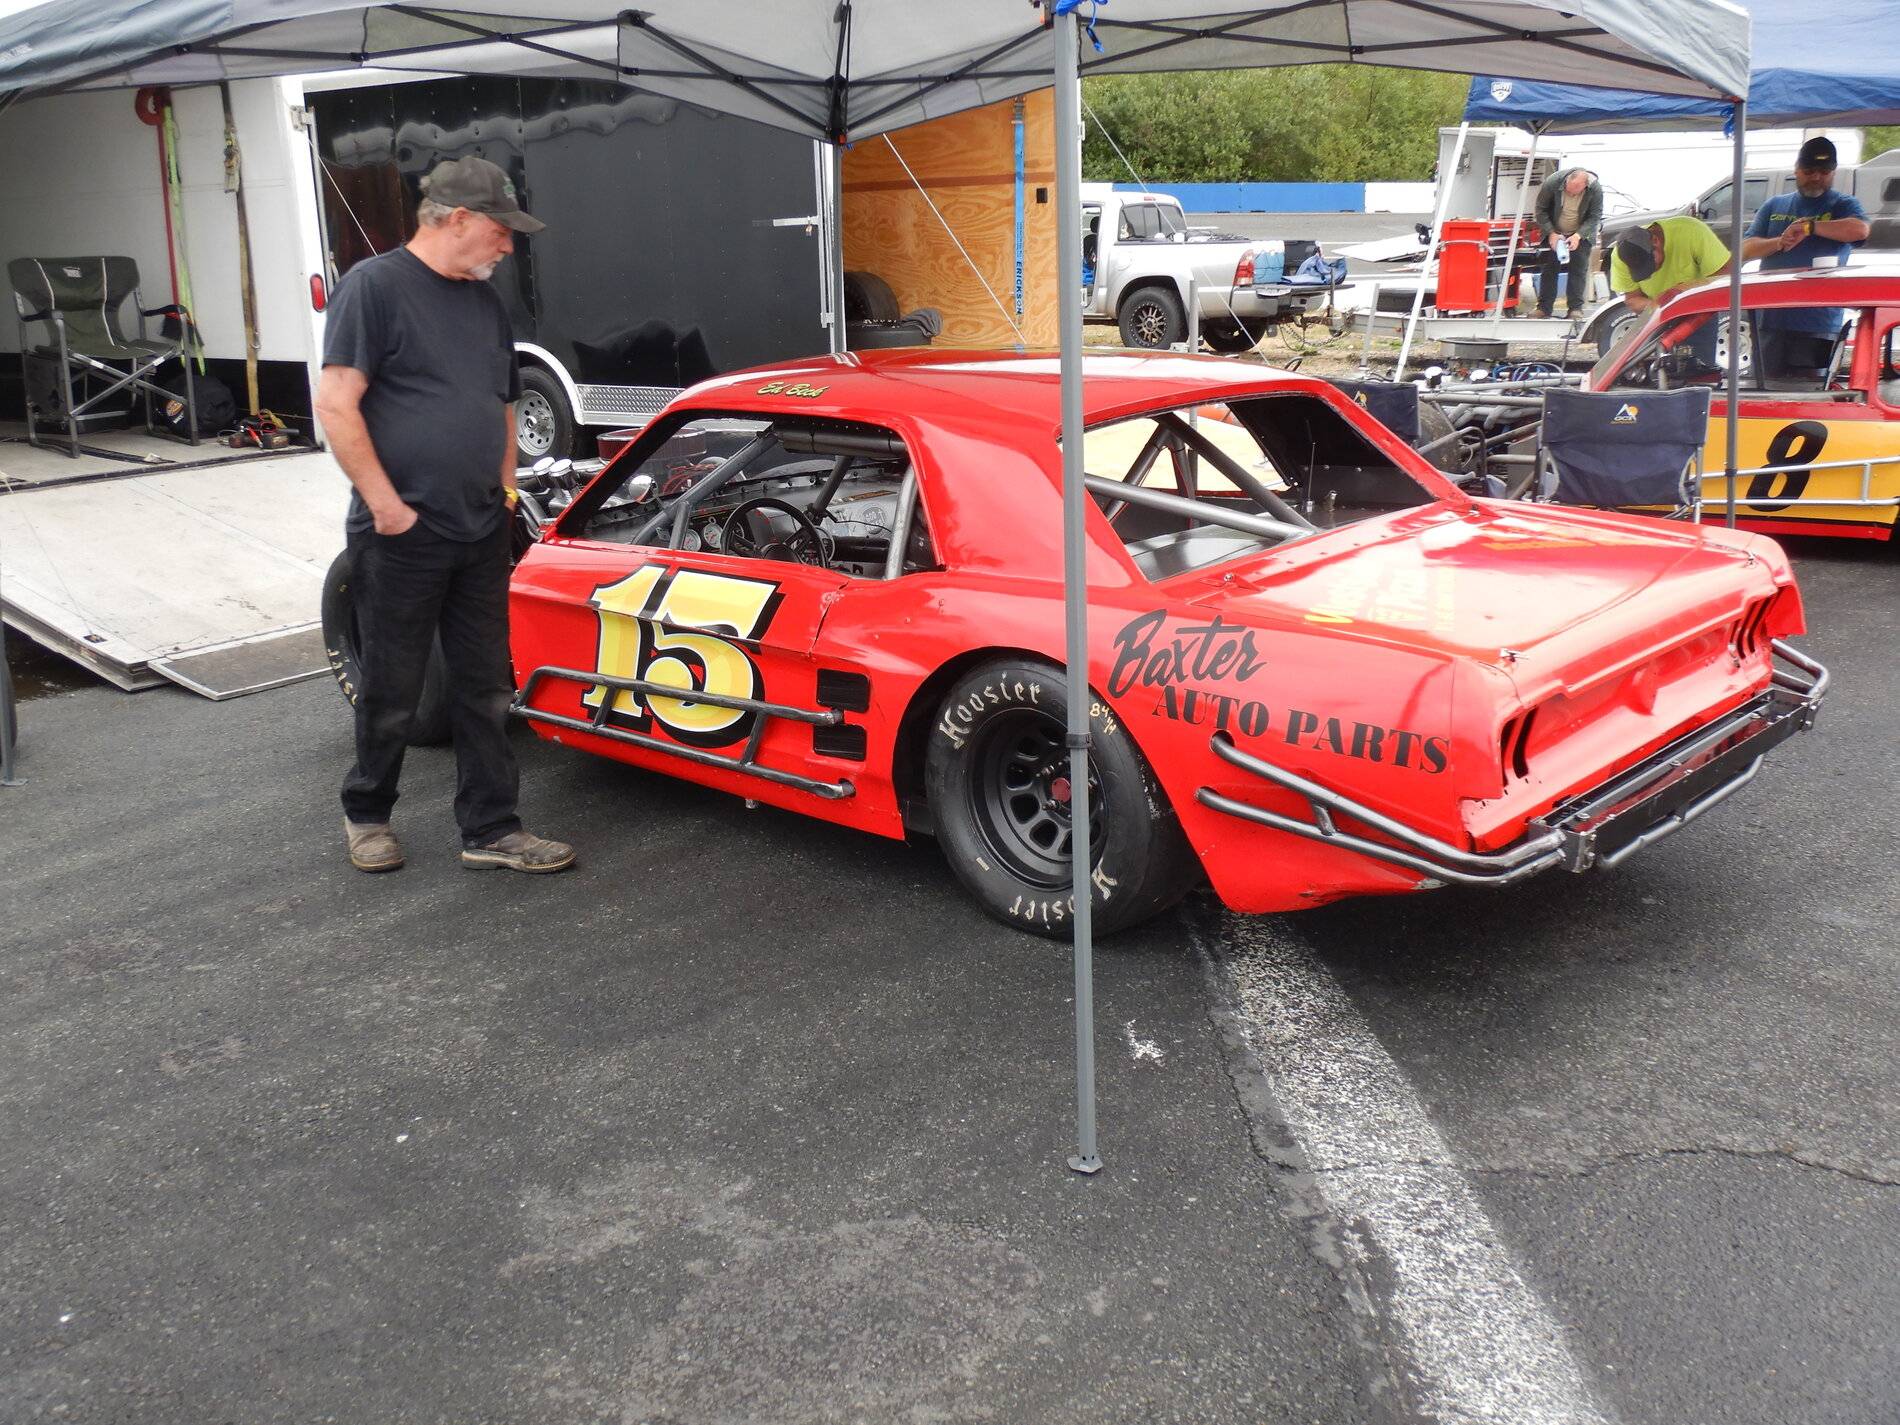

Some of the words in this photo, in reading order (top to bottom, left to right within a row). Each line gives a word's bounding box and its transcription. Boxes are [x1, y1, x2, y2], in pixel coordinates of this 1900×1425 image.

[1015, 261, 1023, 315] ERICKSON
[757, 381, 791, 395] Ed
[785, 383, 831, 398] Beck
[1747, 422, 1828, 511] 8
[582, 564, 784, 747] 15
[1107, 609, 1266, 699] Baxter
[939, 672, 1042, 751] Hoosier
[1152, 685, 1270, 738] AUTO
[1282, 709, 1450, 775] PARTS
[1008, 861, 1118, 930] Hosier
